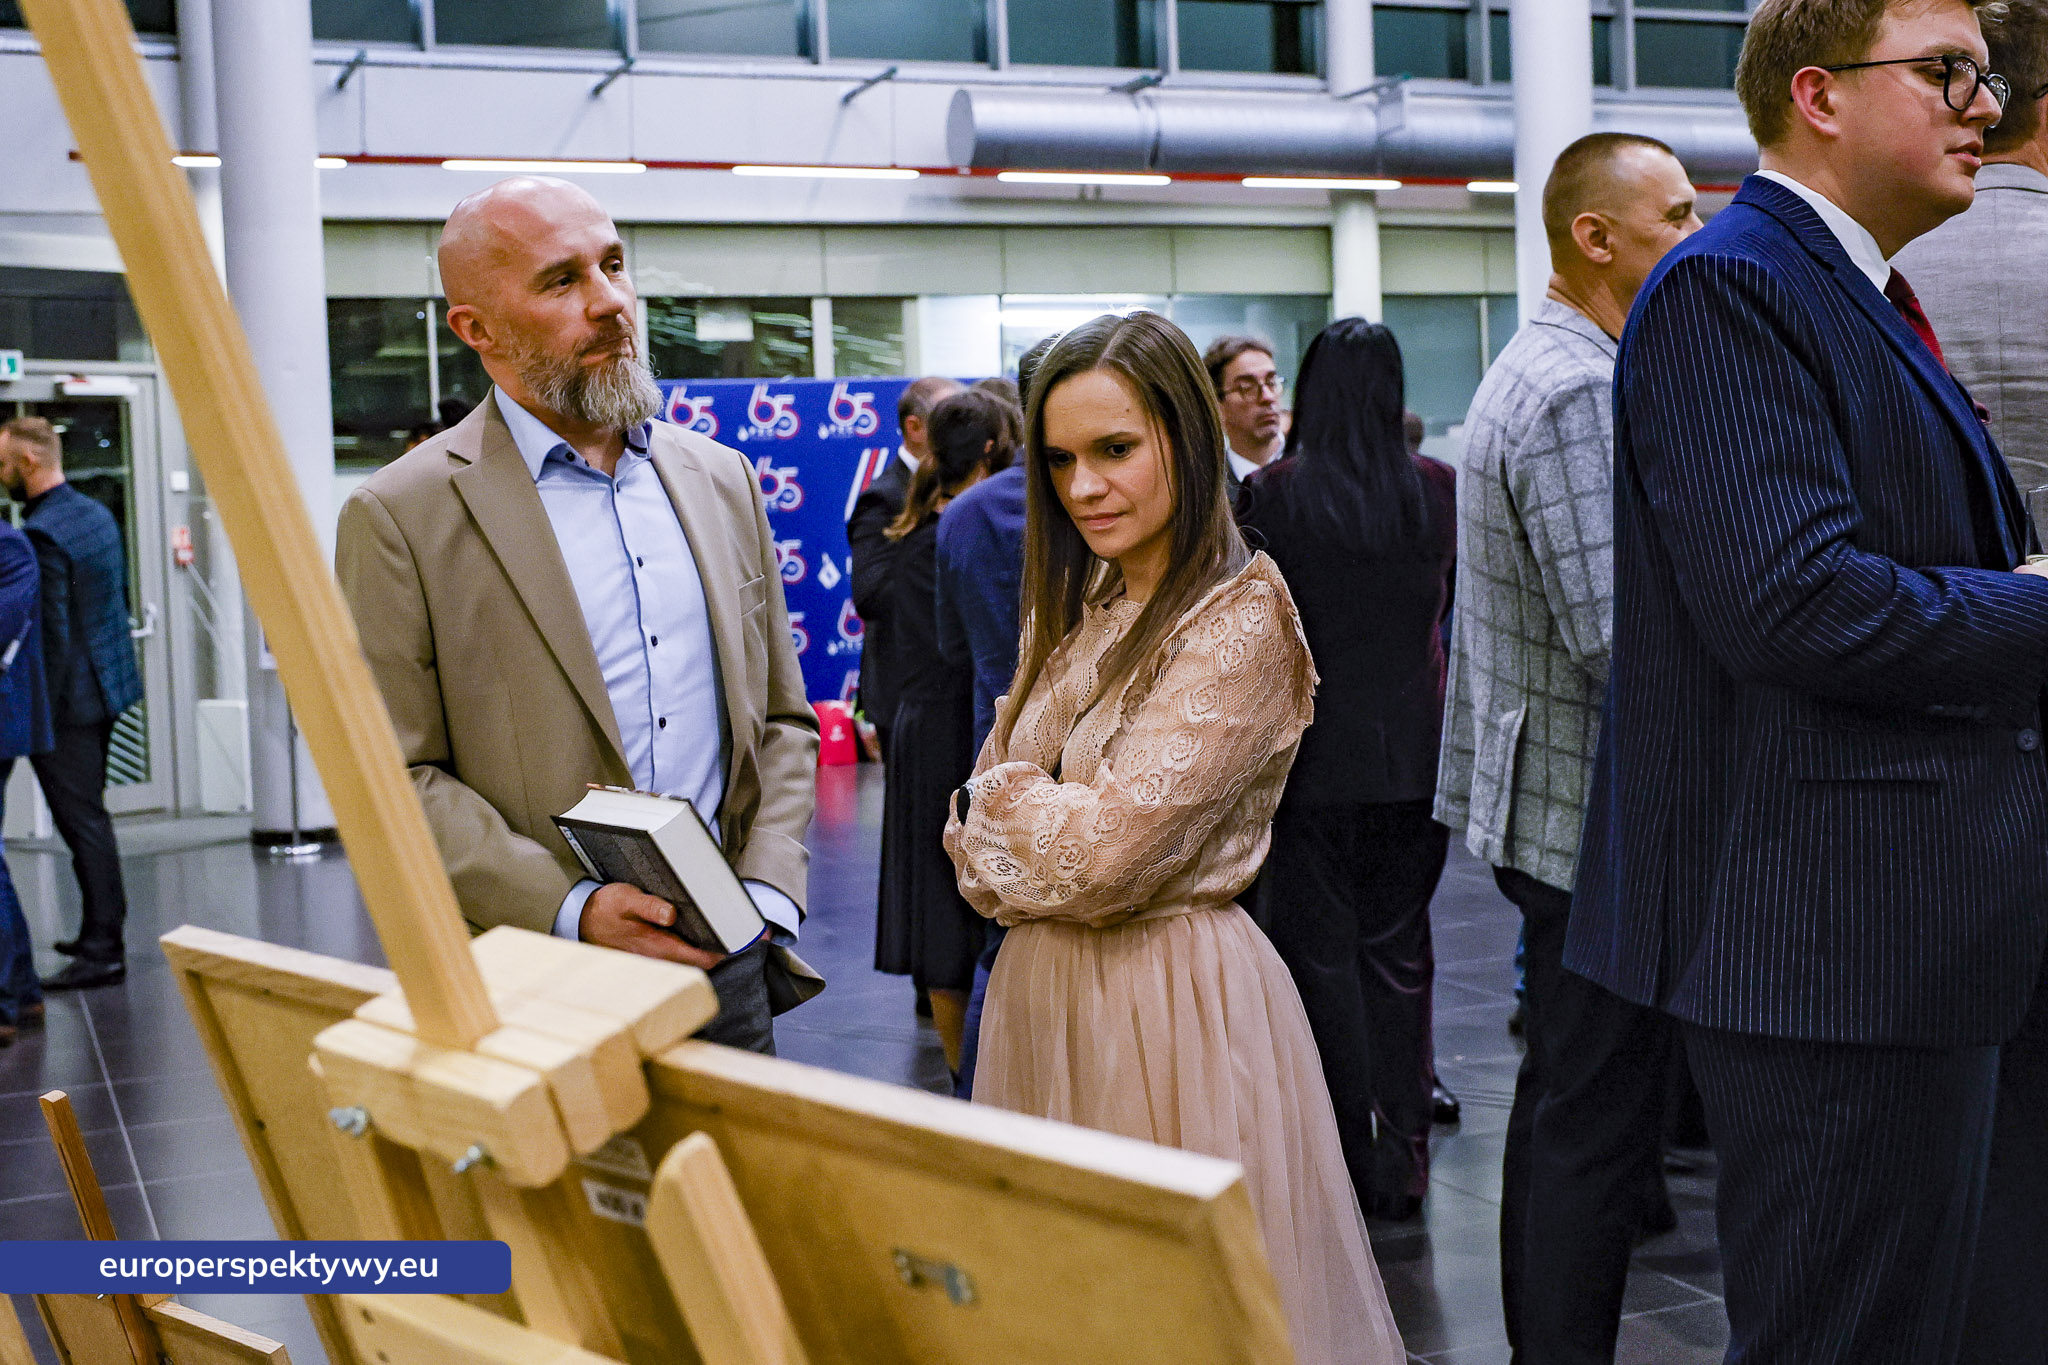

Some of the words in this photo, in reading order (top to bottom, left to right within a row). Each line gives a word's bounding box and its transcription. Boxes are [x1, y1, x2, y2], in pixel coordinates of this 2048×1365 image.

[748, 382, 801, 439] 65
[828, 380, 881, 438] 65
[755, 456, 805, 512] 65
